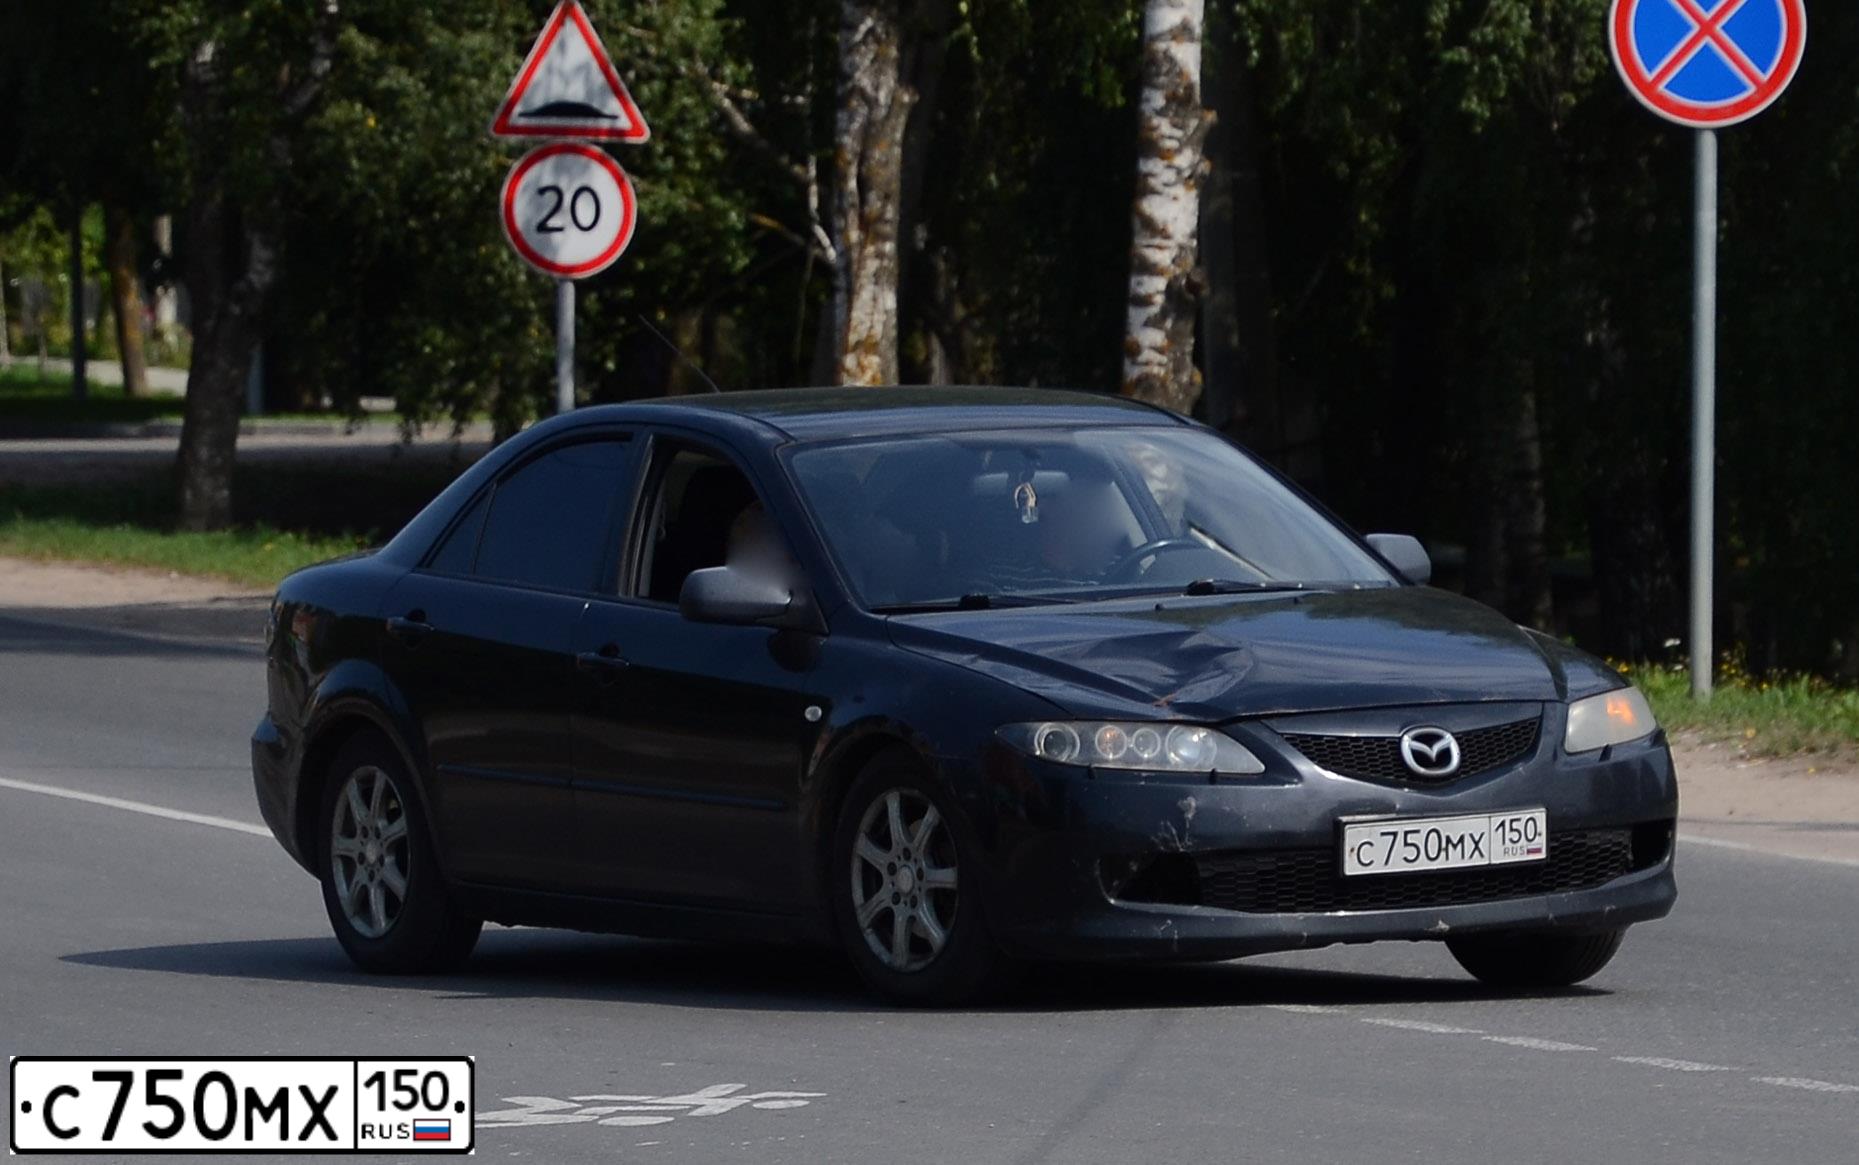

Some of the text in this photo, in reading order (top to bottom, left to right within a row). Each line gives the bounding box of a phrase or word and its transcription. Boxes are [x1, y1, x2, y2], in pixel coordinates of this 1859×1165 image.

[536, 185, 601, 234] 20
[1494, 816, 1539, 846] 150
[1503, 845, 1526, 857] RUS
